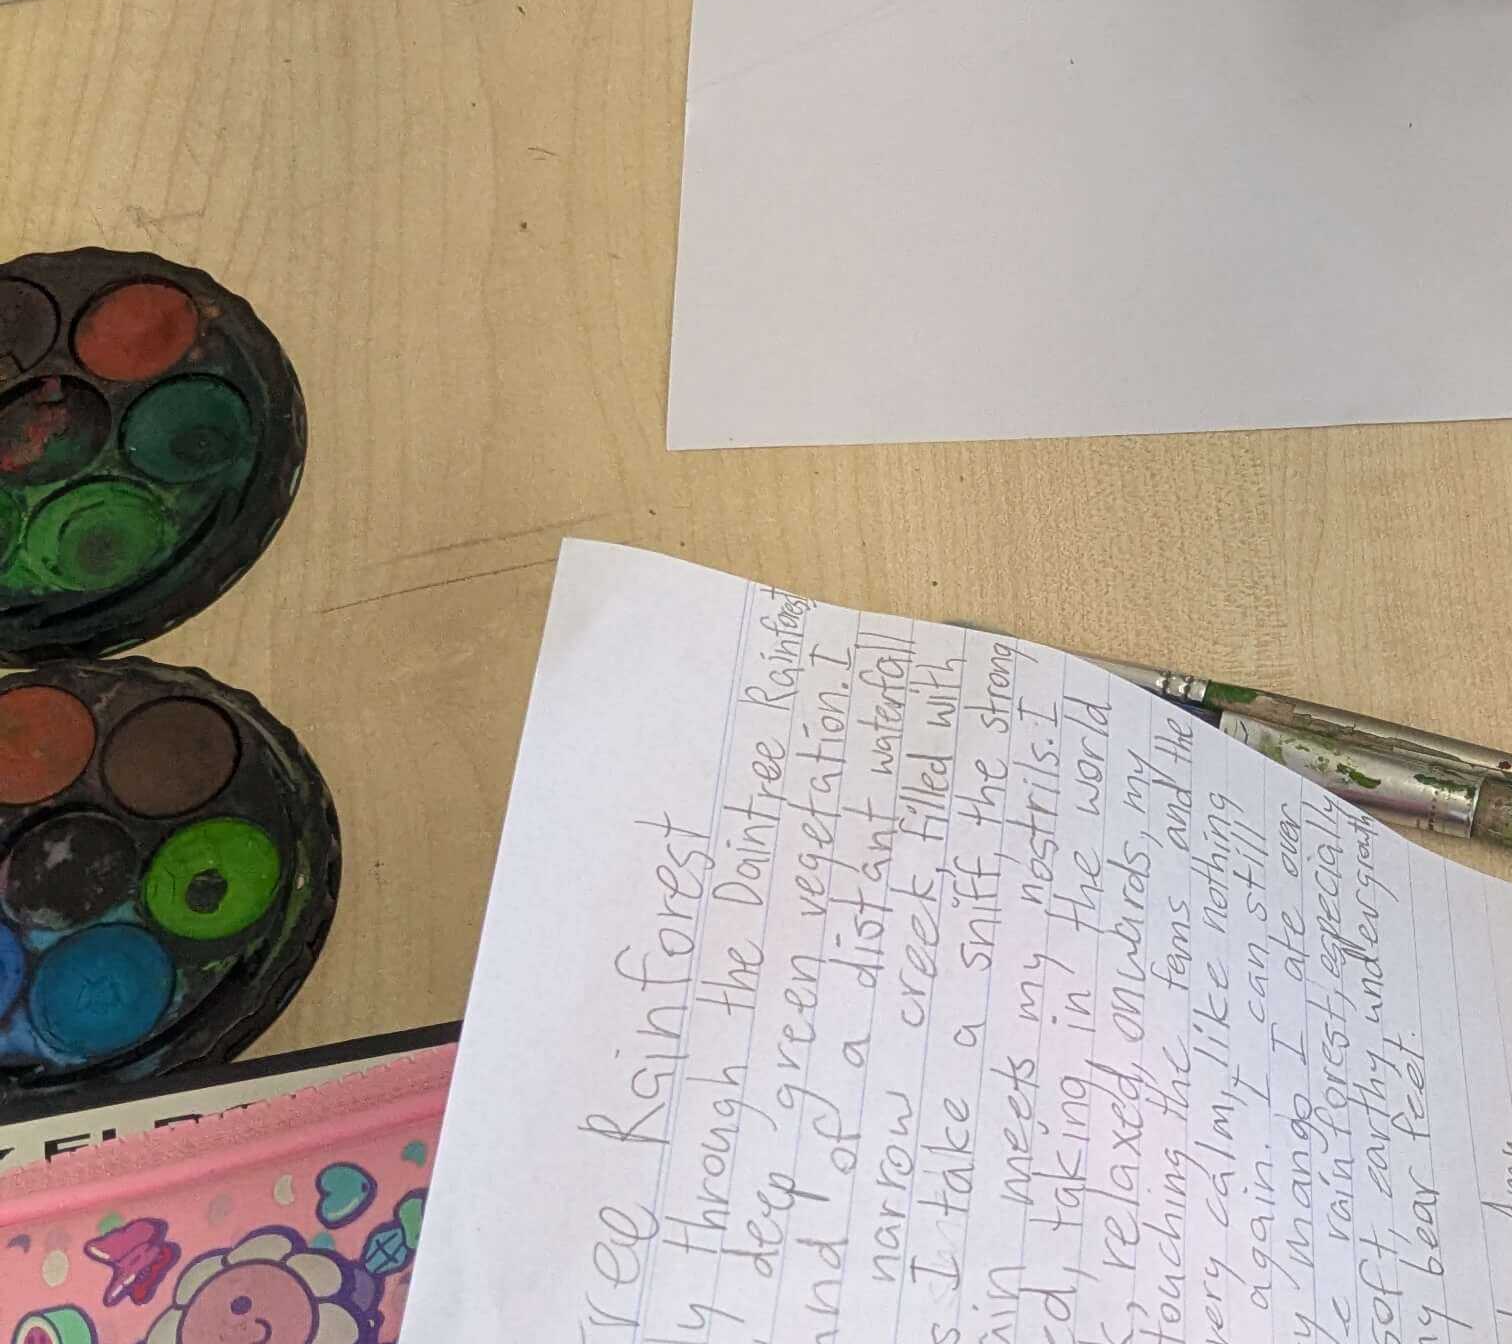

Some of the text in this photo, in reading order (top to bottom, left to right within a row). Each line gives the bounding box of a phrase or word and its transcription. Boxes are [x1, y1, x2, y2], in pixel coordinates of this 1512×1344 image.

[736, 585, 812, 710] Rainforest
[808, 641, 853, 673] I
[851, 628, 917, 773] waterfall
[909, 657, 968, 726] with
[962, 640, 1041, 733] strong
[1019, 694, 1059, 728] I
[1063, 695, 1115, 812] world
[1155, 717, 1196, 764] the
[711, 735, 788, 903] Daintree
[785, 681, 858, 916] vegetation.
[899, 752, 953, 843] filled
[959, 756, 1011, 826] the
[1003, 738, 1065, 902] nostrils.
[1121, 746, 1177, 814] my
[1151, 778, 1193, 852] and
[827, 794, 901, 989] distant
[1043, 846, 1105, 934] the
[1189, 790, 1246, 934] nothing
[1229, 818, 1270, 922] still
[1279, 801, 1303, 878] over
[1299, 793, 1367, 979] especially
[888, 866, 959, 1026] creek,
[952, 851, 1021, 972] sniff,
[1103, 830, 1164, 1042] onwards,
[1267, 903, 1311, 982] ate
[1340, 814, 1400, 1022] undergrowth
[576, 809, 717, 1144] Rainforest
[695, 939, 765, 1015] the
[1015, 952, 1076, 1021] my
[1049, 985, 1097, 1031] in
[1189, 959, 1233, 1068] like
[1246, 941, 1271, 1024] can
[775, 957, 840, 1112] green
[843, 1033, 872, 1069] a
[953, 1020, 987, 1048] a
[1142, 1032, 1192, 1121] the
[1237, 1062, 1272, 1107] I
[1271, 1020, 1307, 1066] I
[1381, 1031, 1432, 1141] feet.
[661, 1063, 778, 1254] through
[813, 1111, 861, 1175] of
[915, 1096, 975, 1217] take
[989, 1053, 1041, 1204] meets
[1083, 1057, 1157, 1269] relaxed,
[1193, 1091, 1249, 1228] calm,
[1272, 1091, 1329, 1267] mango
[719, 1169, 831, 1277] deep
[871, 1090, 915, 1282] narrow
[1244, 1141, 1302, 1310] again.
[1397, 1164, 1446, 1276] bear
[910, 1252, 962, 1291] I
[1139, 1146, 1211, 1344] touching
